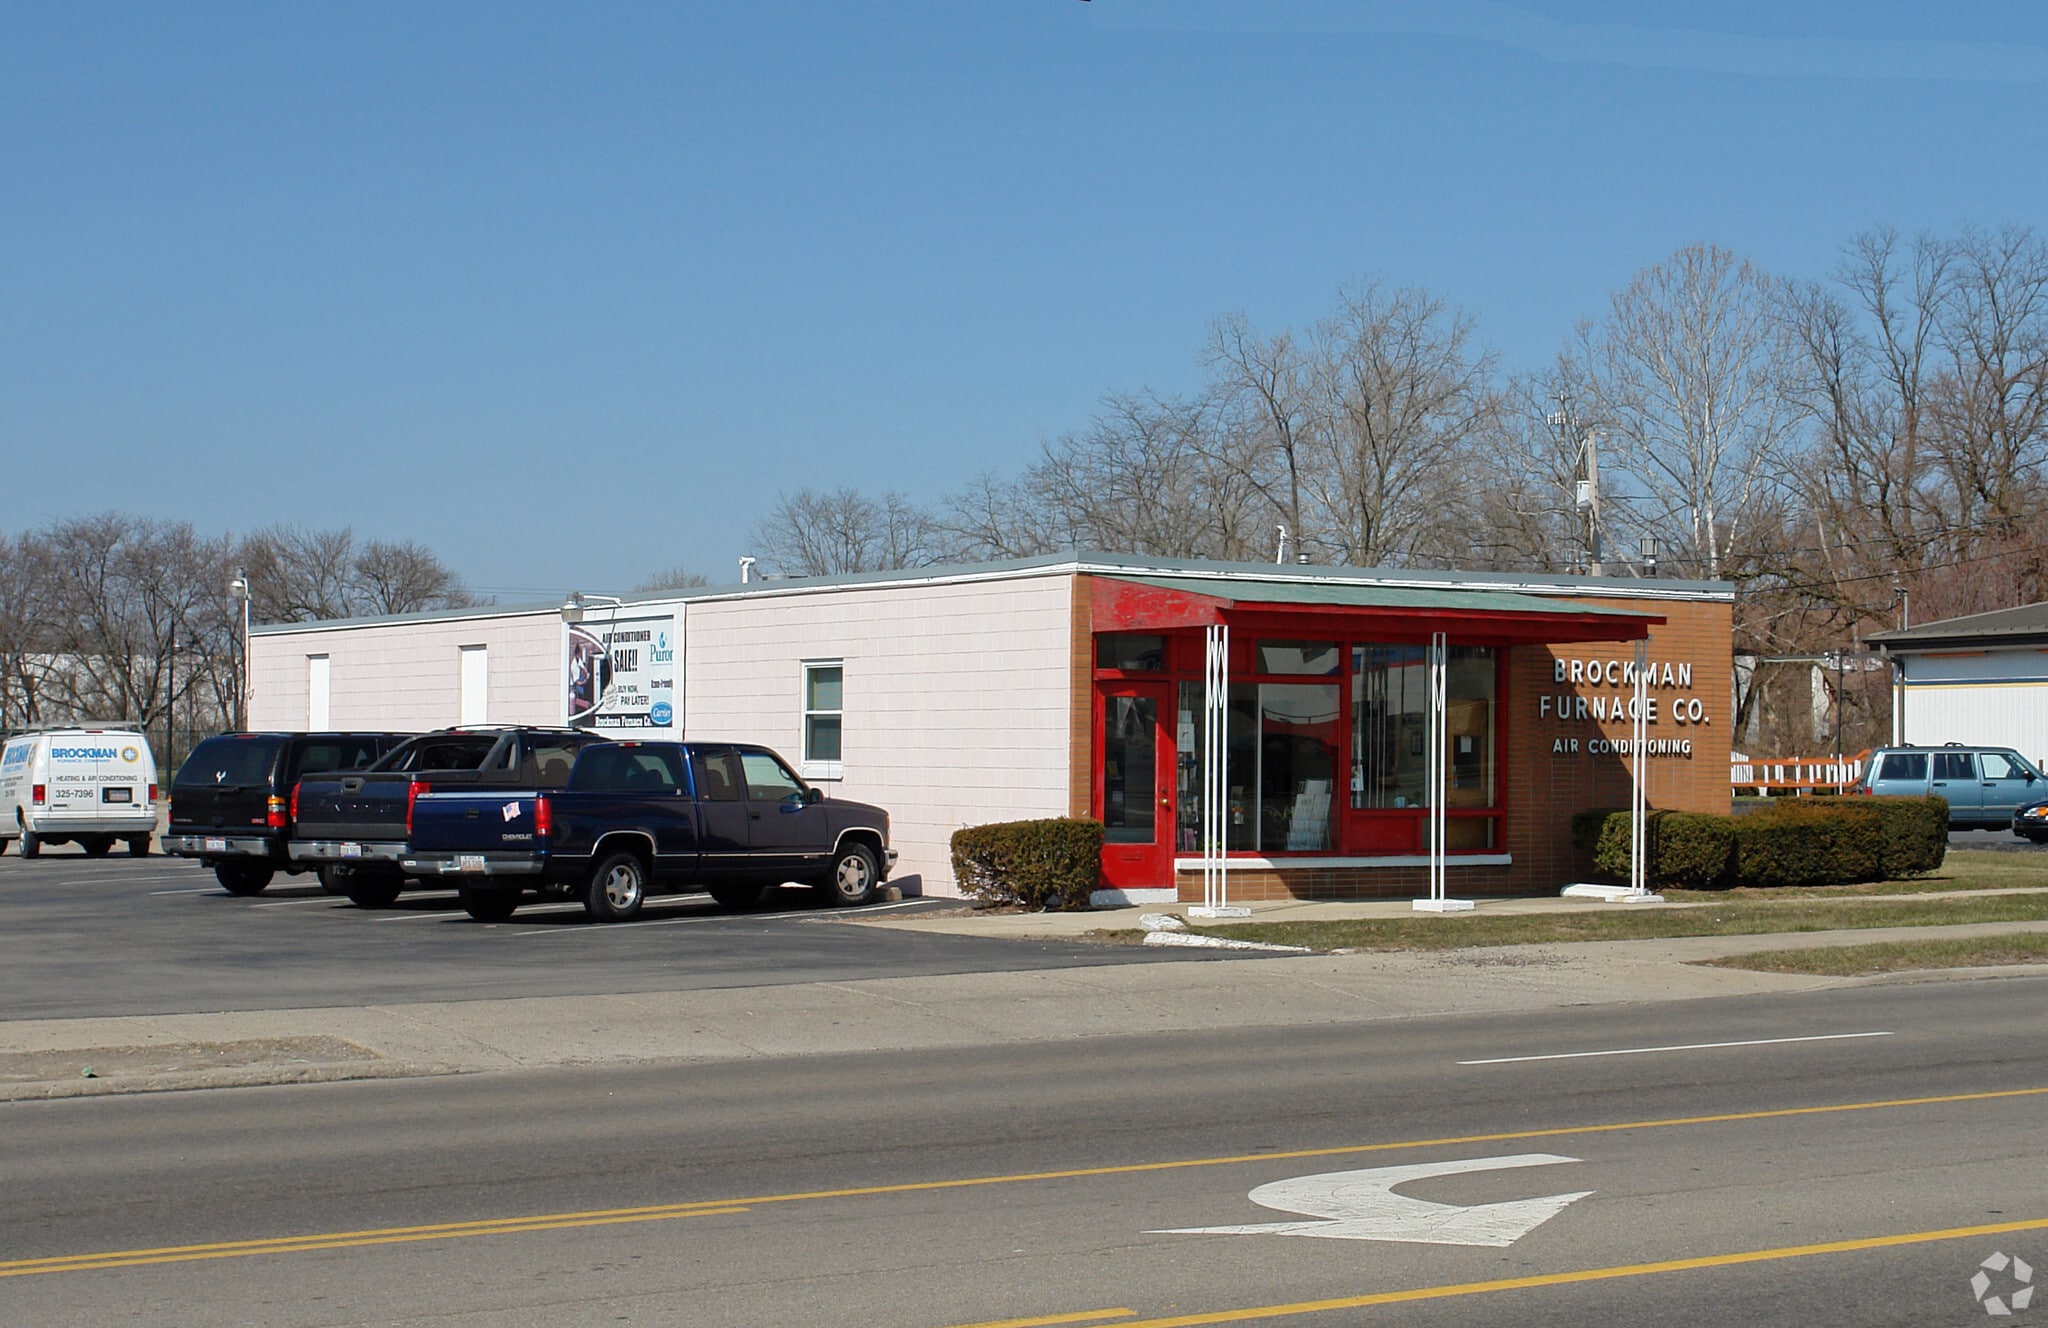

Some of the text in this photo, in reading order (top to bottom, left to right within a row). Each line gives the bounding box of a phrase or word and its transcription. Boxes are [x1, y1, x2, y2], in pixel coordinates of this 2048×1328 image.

[613, 630, 651, 643] CONDITIONER
[614, 649, 638, 673] SALE!!
[1554, 658, 1691, 686] BROCKMAN
[620, 696, 631, 706] PAY
[1539, 696, 1710, 722] FURNACE CO.
[52, 748, 117, 758] BROCKMAN
[1553, 738, 1691, 754] AIR CONDITONING
[55, 789, 94, 798] 325-7396
